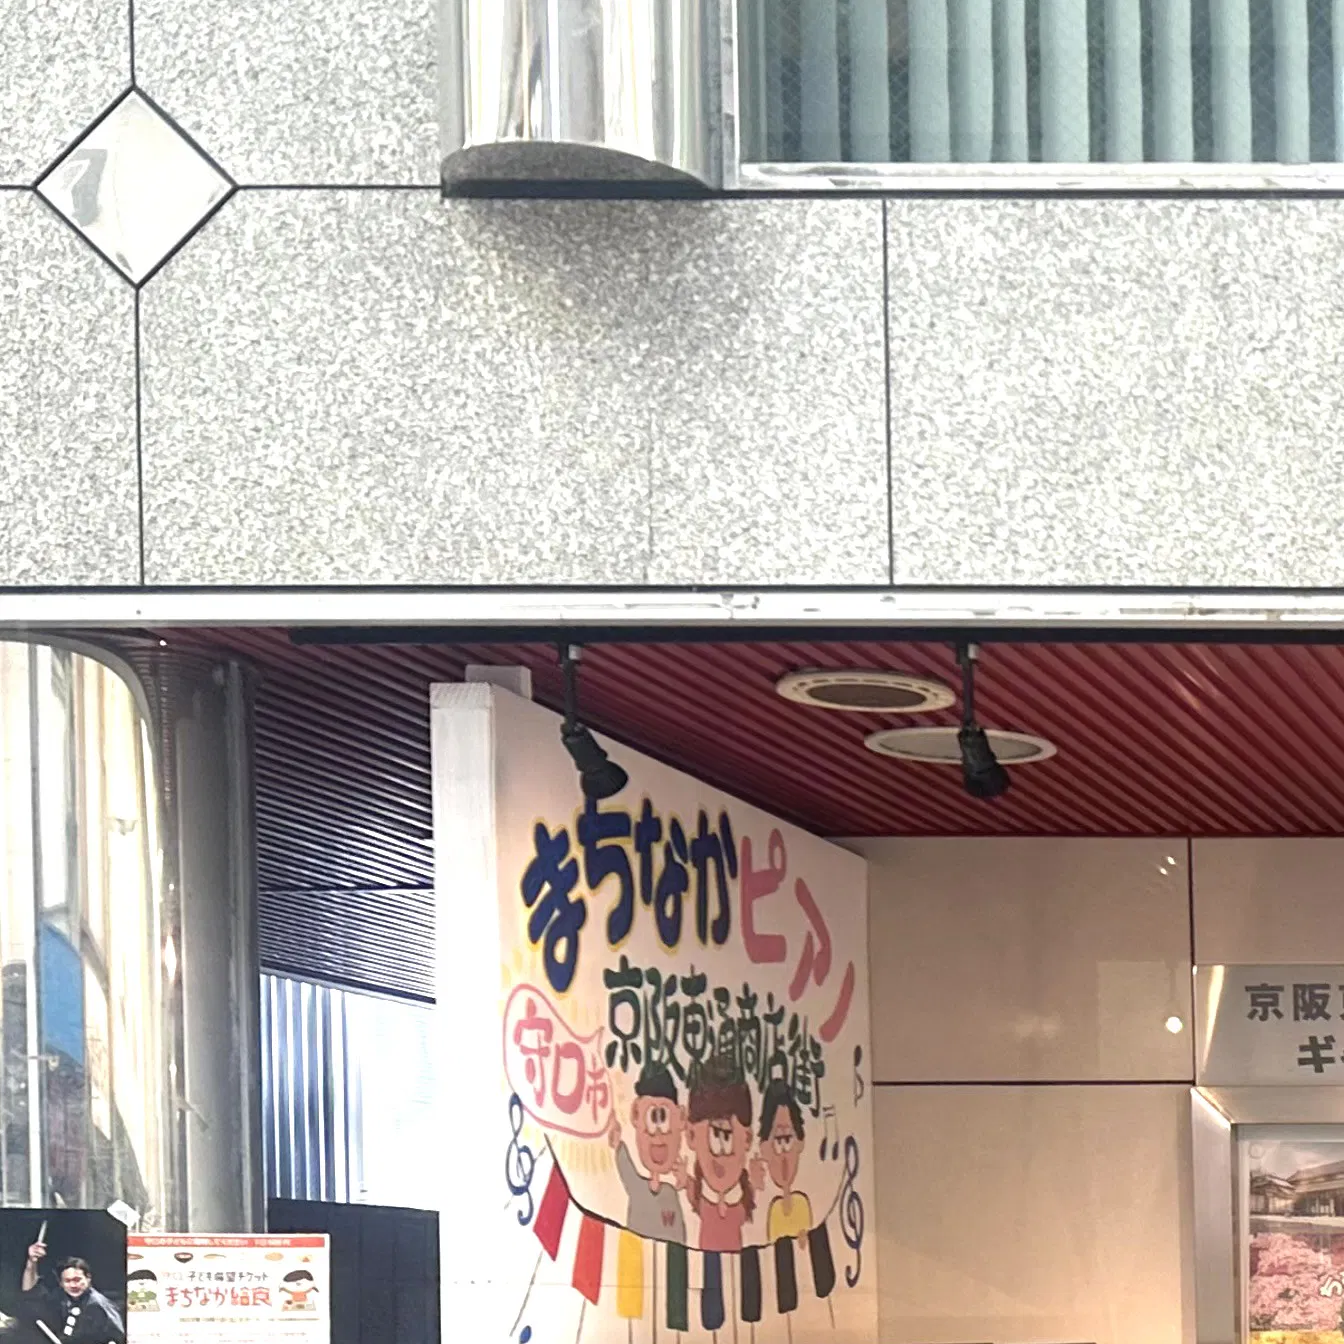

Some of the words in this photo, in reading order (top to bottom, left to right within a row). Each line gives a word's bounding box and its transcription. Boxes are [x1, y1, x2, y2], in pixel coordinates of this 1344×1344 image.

[513, 998, 609, 1113] 守口市
[165, 1286, 273, 1308] まちなか給食
